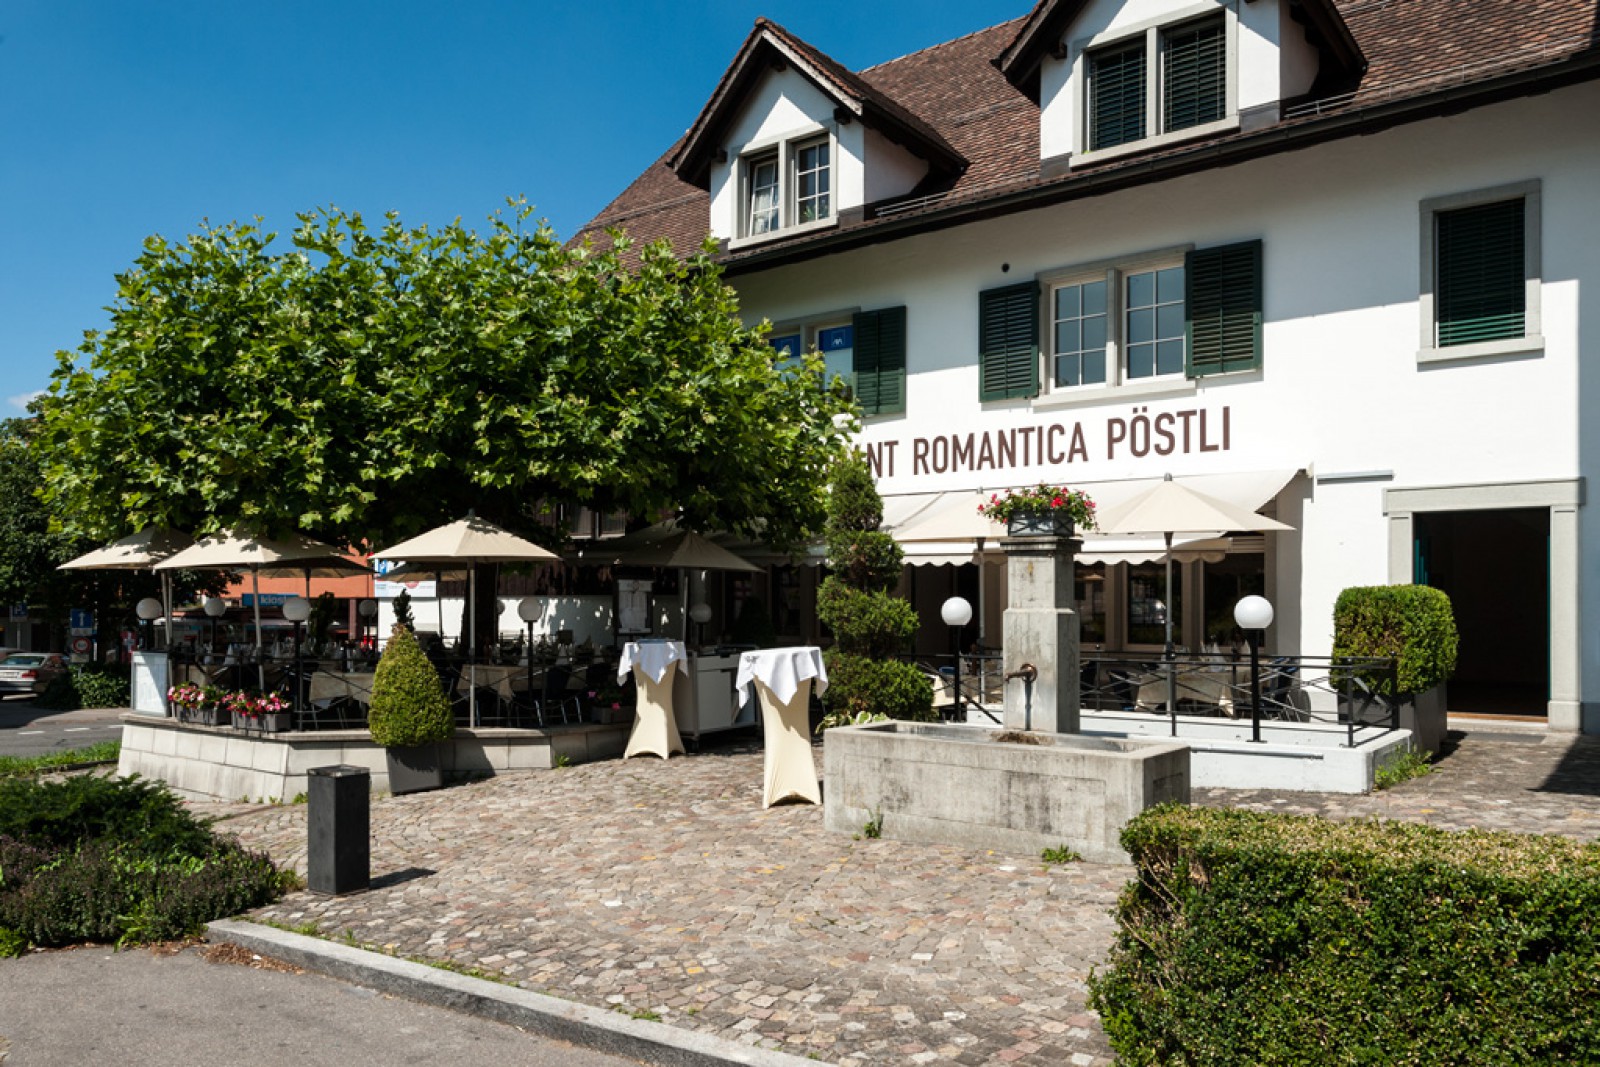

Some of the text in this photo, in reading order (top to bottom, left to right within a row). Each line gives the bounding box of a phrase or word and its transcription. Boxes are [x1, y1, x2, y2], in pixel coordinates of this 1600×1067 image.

[854, 406, 1231, 478] NT ROMANTICA PÖSTLI
[260, 595, 287, 604] kios
